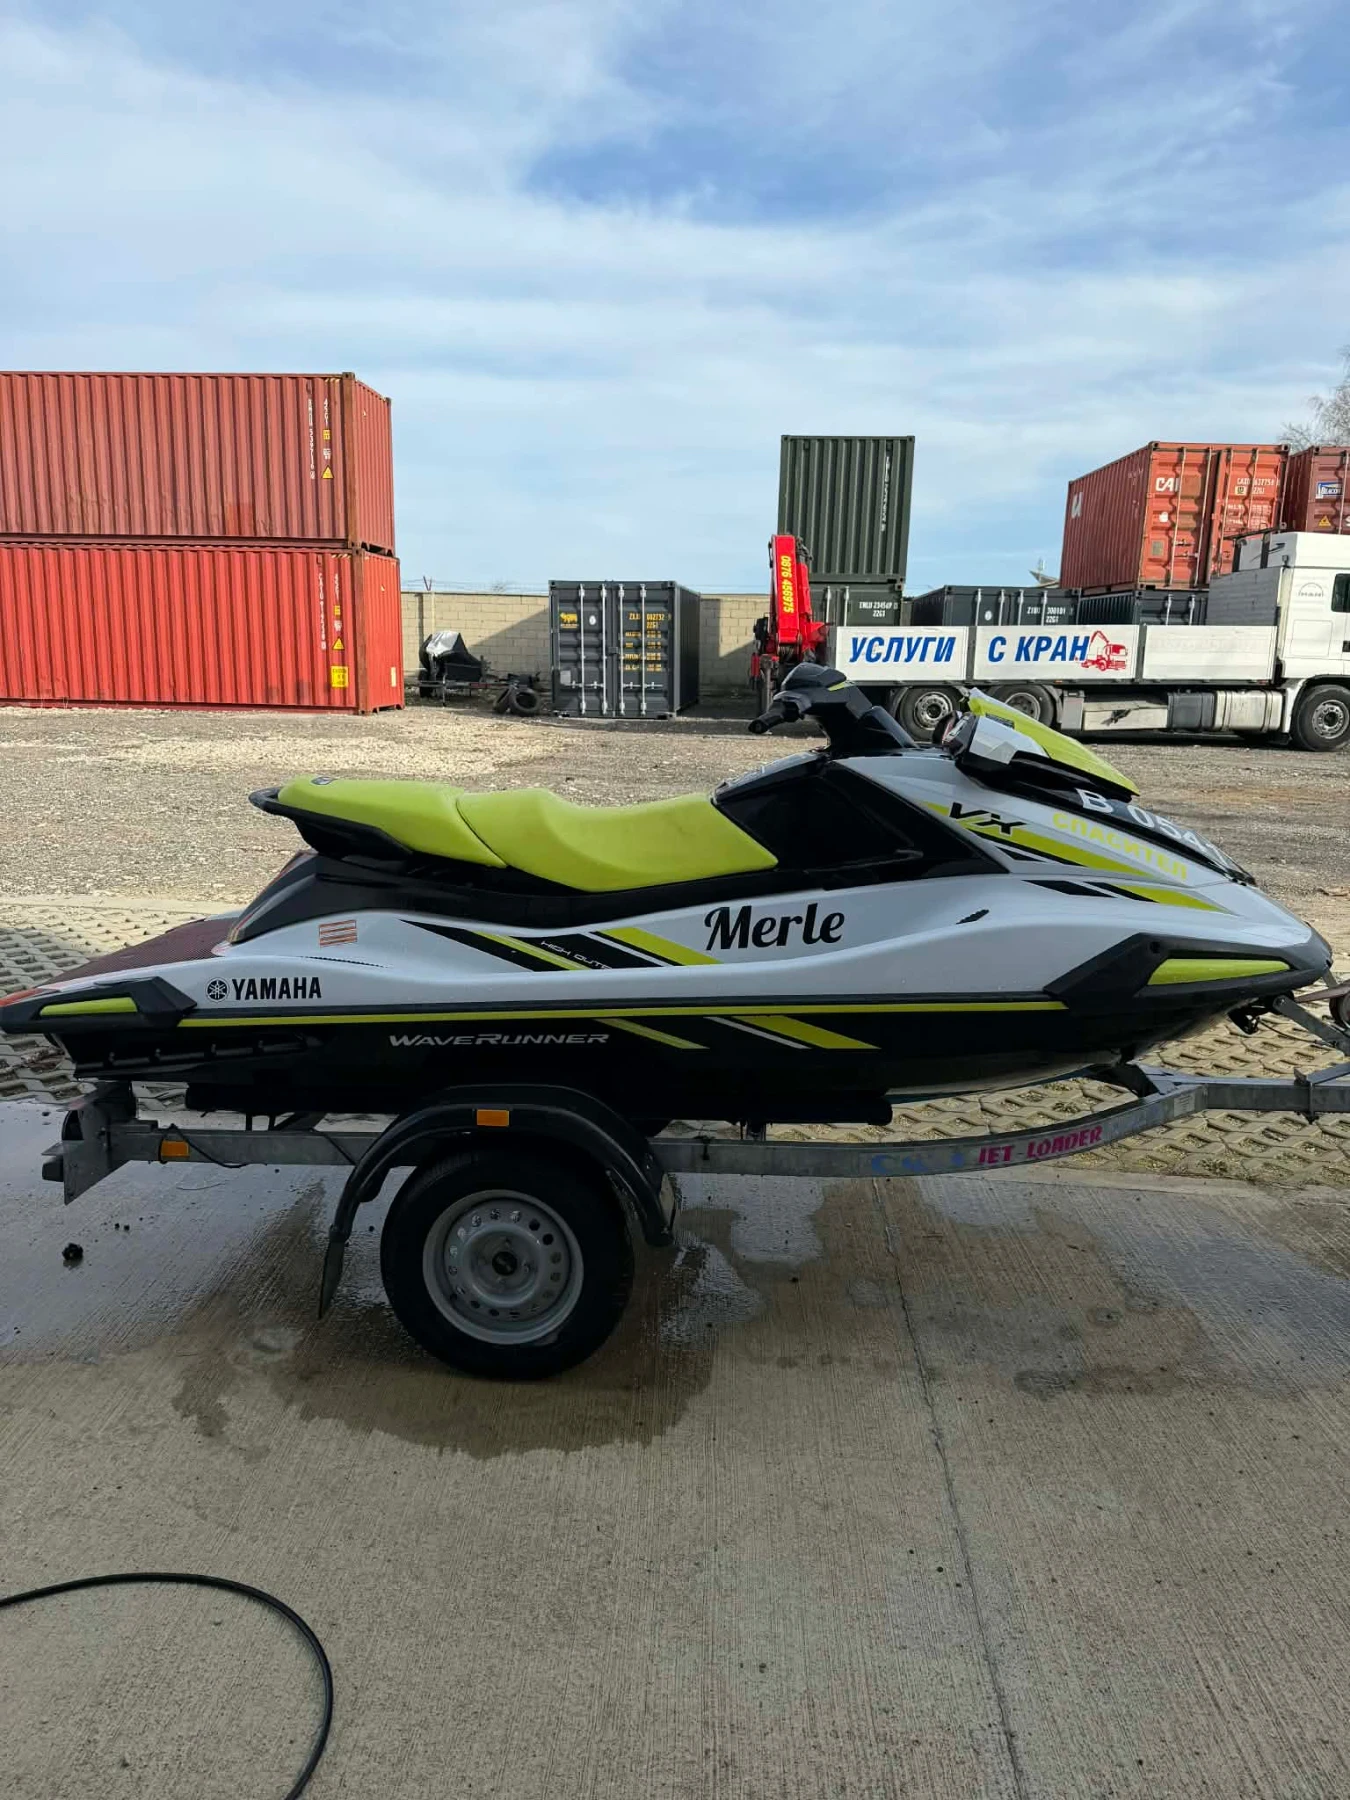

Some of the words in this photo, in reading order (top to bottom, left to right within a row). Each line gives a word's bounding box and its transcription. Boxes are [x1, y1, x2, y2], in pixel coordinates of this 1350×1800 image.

[780, 555, 792, 578] 0876
[782, 579, 795, 613] 456975
[849, 636, 956, 663] УСЛУГИ
[988, 636, 1007, 663] С
[1015, 635, 1091, 662] КРАН
[949, 801, 1026, 836] VX
[1052, 812, 1188, 882] СПАСИТЕЛ
[705, 902, 846, 952] Merle
[232, 976, 323, 1001] YAMAHA
[1026, 1125, 1103, 1160] LOADER
